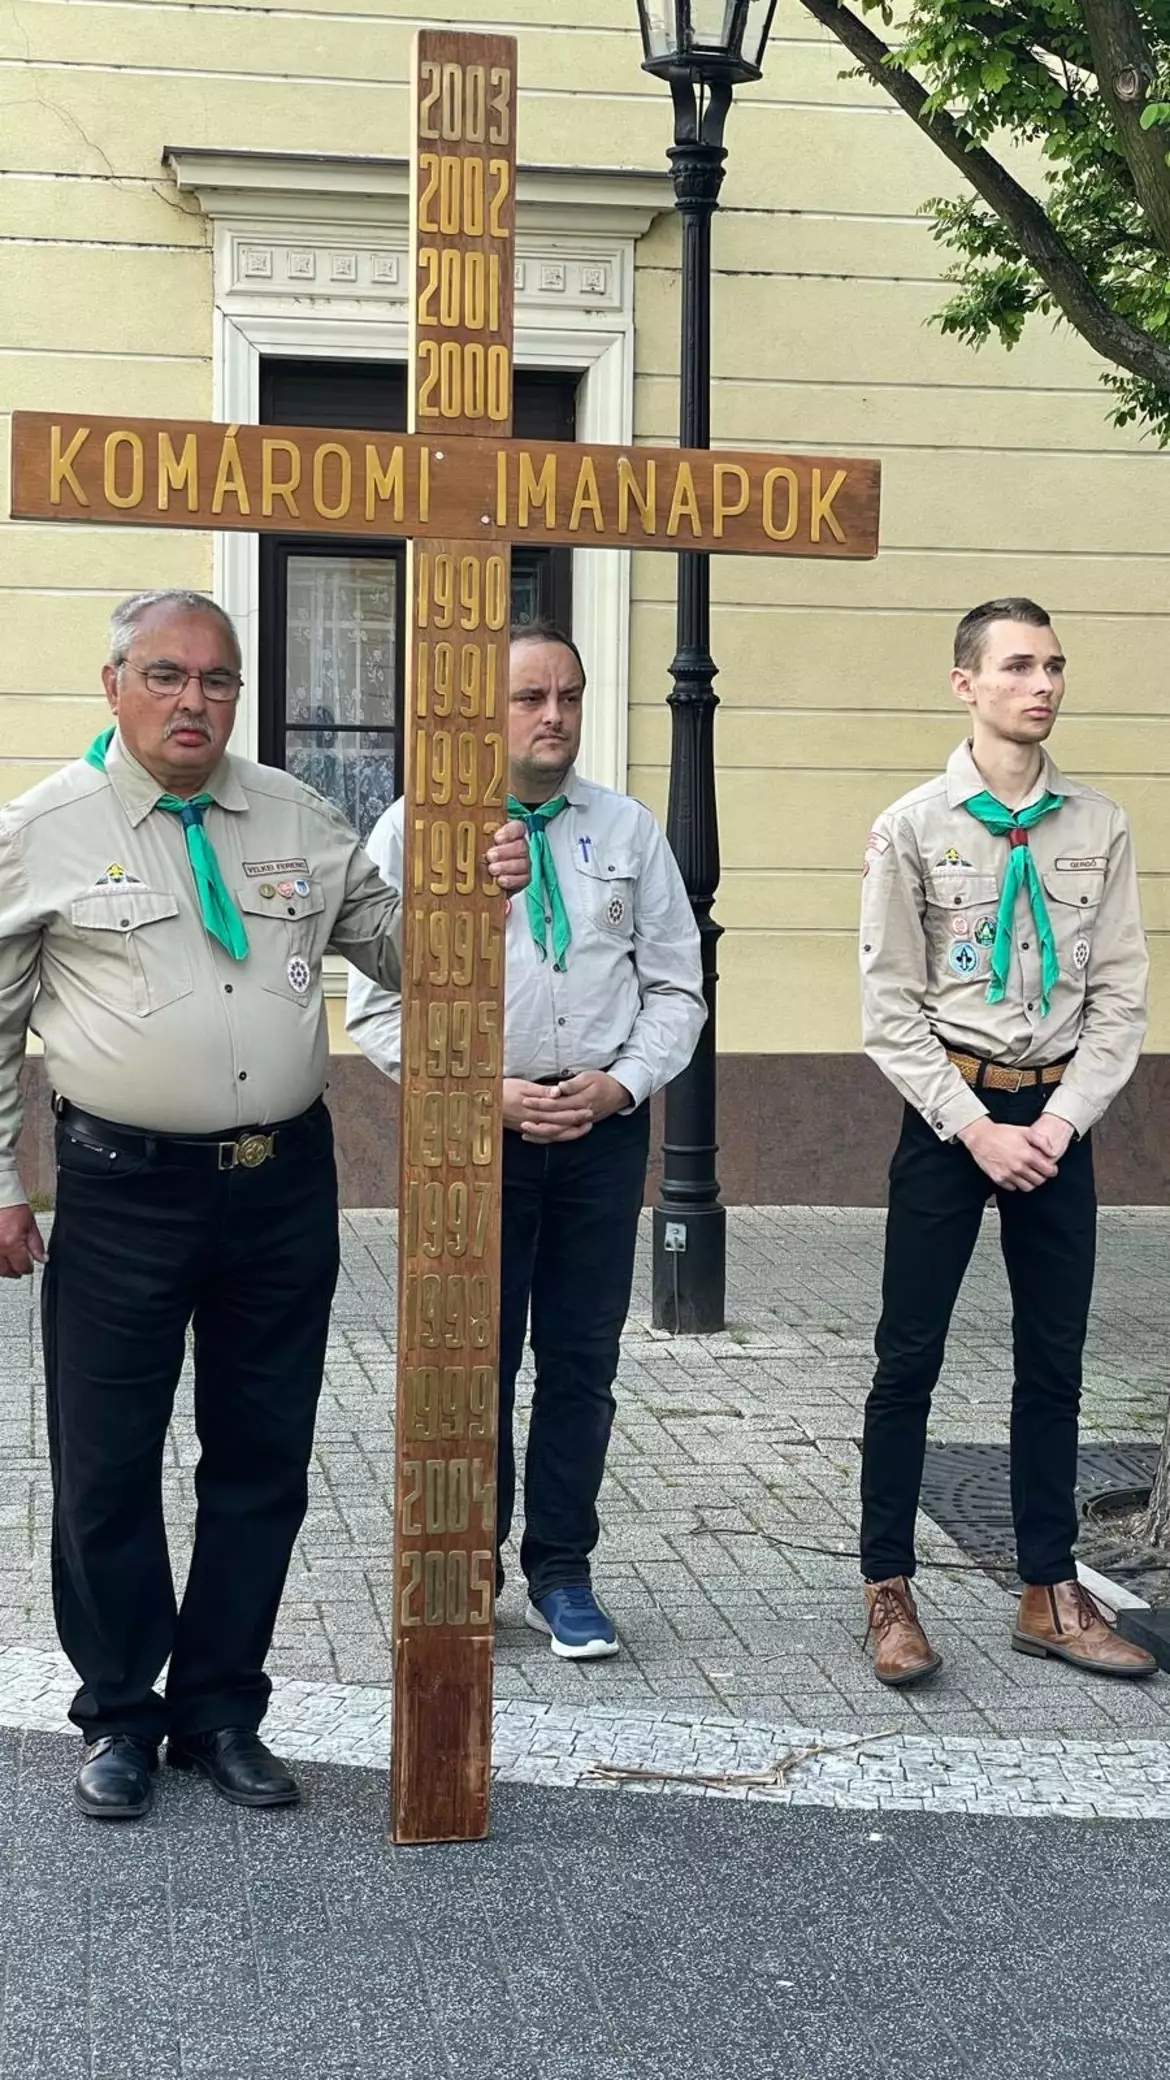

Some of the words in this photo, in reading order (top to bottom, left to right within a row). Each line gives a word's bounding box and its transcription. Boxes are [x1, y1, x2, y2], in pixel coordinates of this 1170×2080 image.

[420, 61, 511, 146] 2003
[418, 153, 510, 238] 2002
[418, 247, 499, 332] 2001
[418, 340, 509, 421] 2000
[49, 424, 430, 524] KOMÁROMI
[496, 450, 848, 544] IMANAPOK
[416, 553, 506, 631] 1990
[415, 641, 497, 720] 1991
[415, 729, 503, 808] 1992
[246, 864, 275, 873] VELKEI
[276, 861, 305, 870] FERENC
[411, 910, 500, 988] 1994
[410, 1000, 499, 1079] 1995
[408, 1090, 494, 1168] 1996
[406, 1181, 494, 1259] 1997
[406, 1274, 493, 1350] 1998
[405, 1365, 494, 1441] 1999
[402, 1457, 495, 1537] 2004
[401, 1549, 493, 1627] 2005
